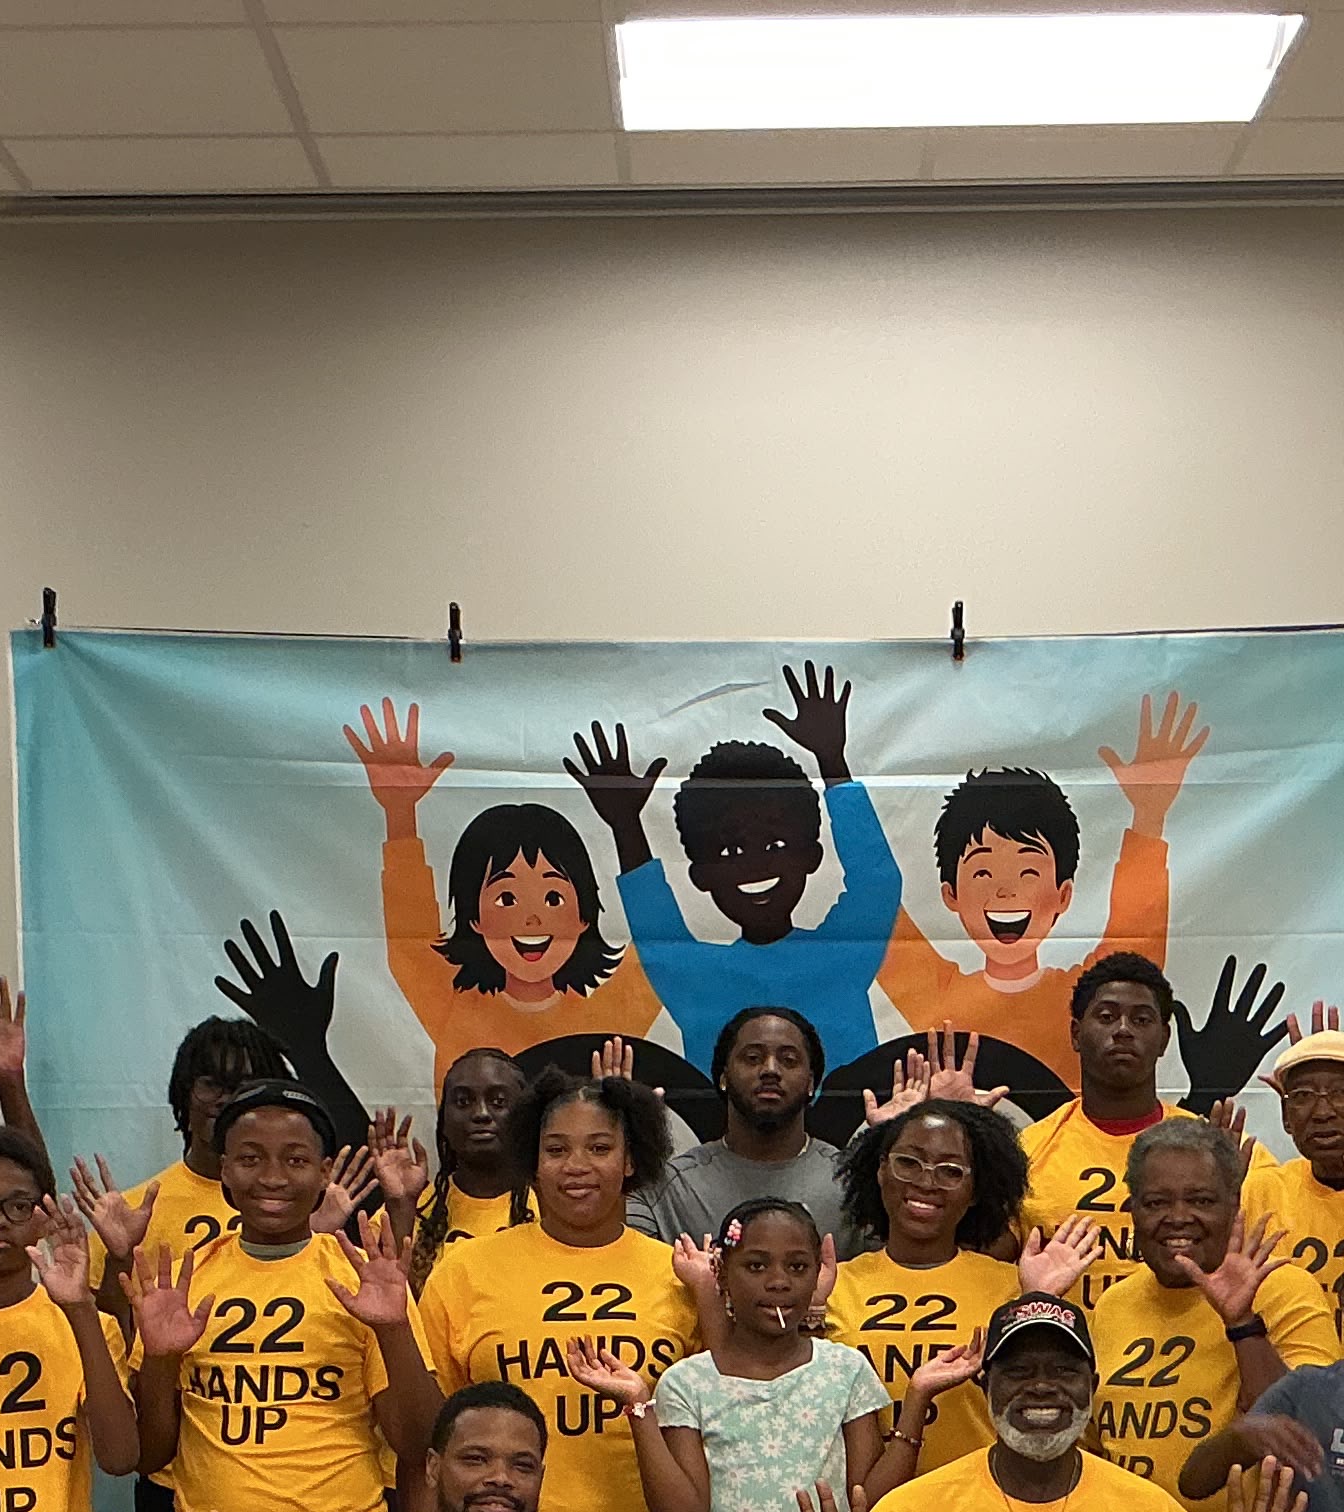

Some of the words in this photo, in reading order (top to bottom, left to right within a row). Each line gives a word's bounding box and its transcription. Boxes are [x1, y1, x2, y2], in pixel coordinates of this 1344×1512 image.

[1075, 1167, 1131, 1213] 2
[542, 1282, 637, 1322] 22
[860, 1294, 957, 1331] 22
[210, 1298, 305, 1352] 22
[1105, 1336, 1195, 1387] 22
[221, 1405, 288, 1446] UP
[557, 1393, 622, 1436] UP
[1097, 1396, 1213, 1439] ANDS
